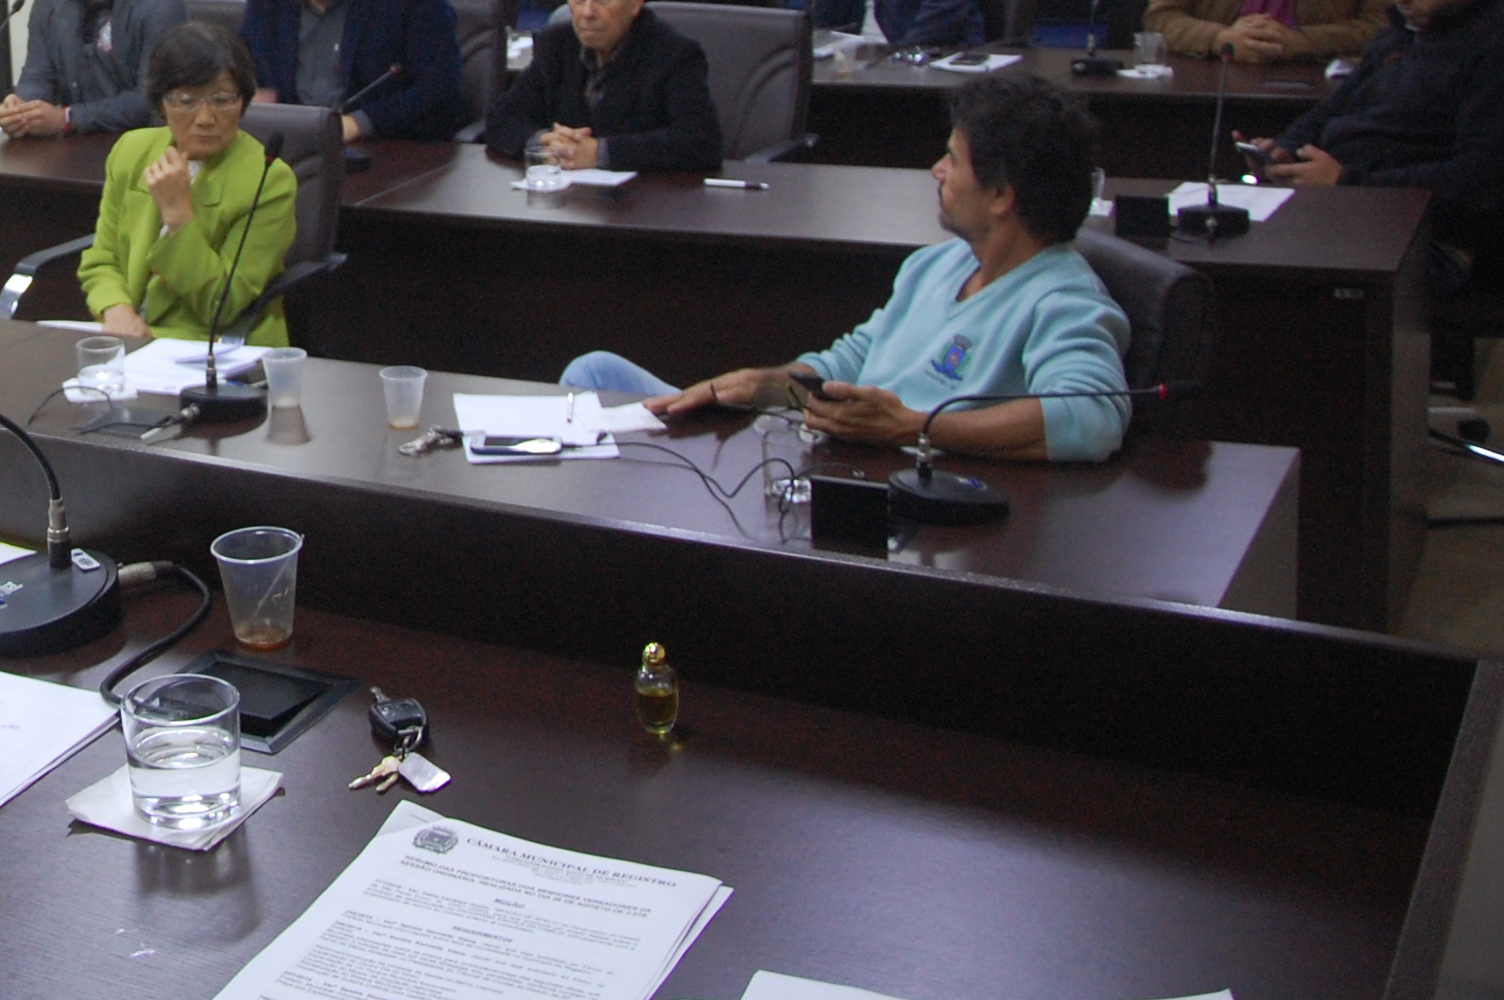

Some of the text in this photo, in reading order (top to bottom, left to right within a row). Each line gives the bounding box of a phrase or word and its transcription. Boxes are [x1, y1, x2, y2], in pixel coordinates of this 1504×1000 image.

[466, 838, 516, 856] CÂMARA
[520, 852, 587, 872] MUNICIPAL
[591, 868, 609, 876] DE
[612, 872, 677, 887] REGISTRO
